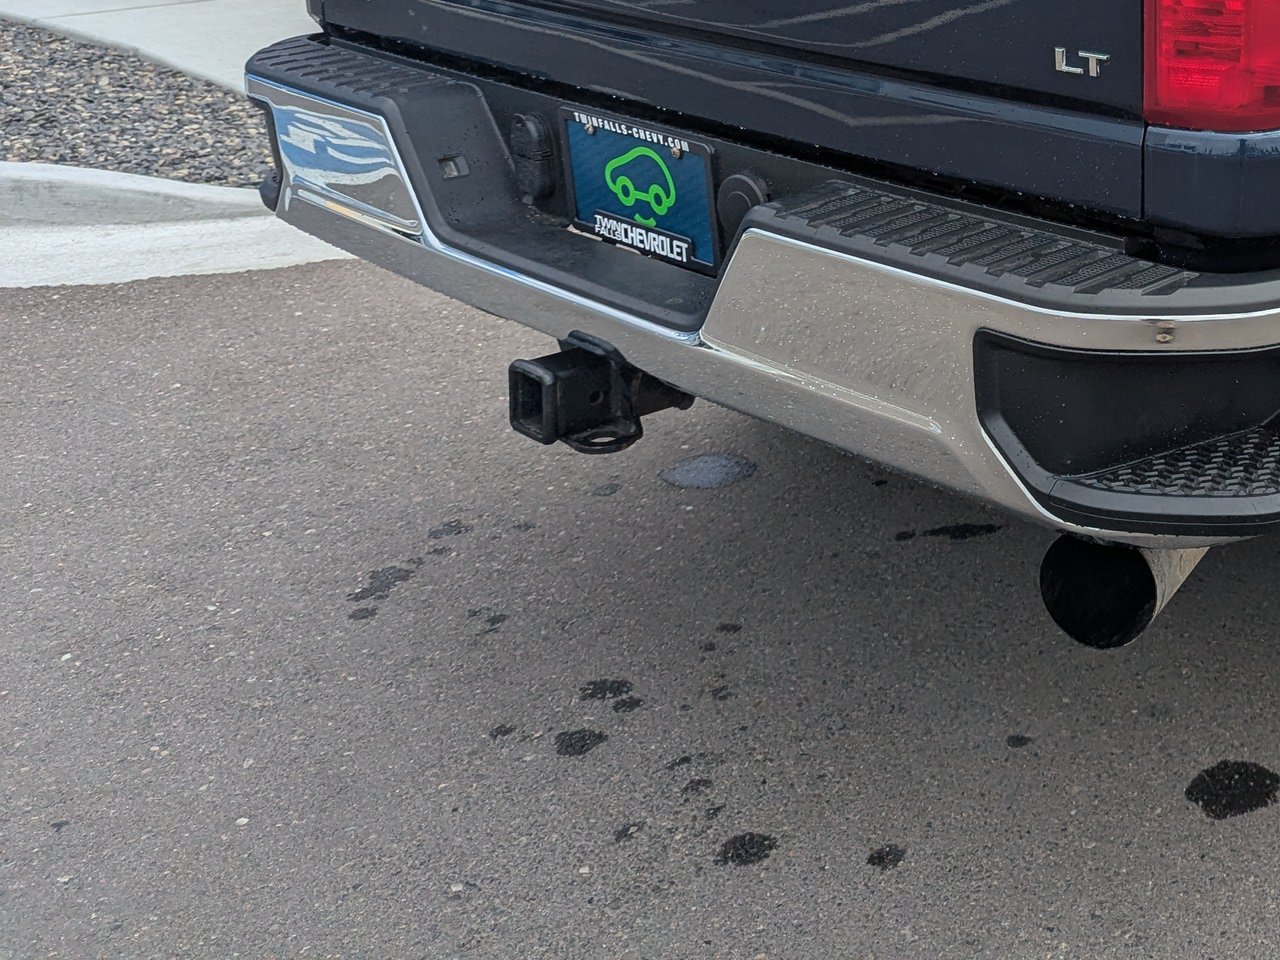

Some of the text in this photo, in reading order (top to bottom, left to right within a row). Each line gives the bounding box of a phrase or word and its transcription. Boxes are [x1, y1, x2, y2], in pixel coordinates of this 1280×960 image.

[1054, 45, 1112, 78] LT
[573, 112, 690, 153] TWINFALLS-CHEVY.COM
[594, 214, 621, 232] TWIN
[595, 224, 621, 241] FALLS
[621, 223, 688, 263] CHEVROLET
